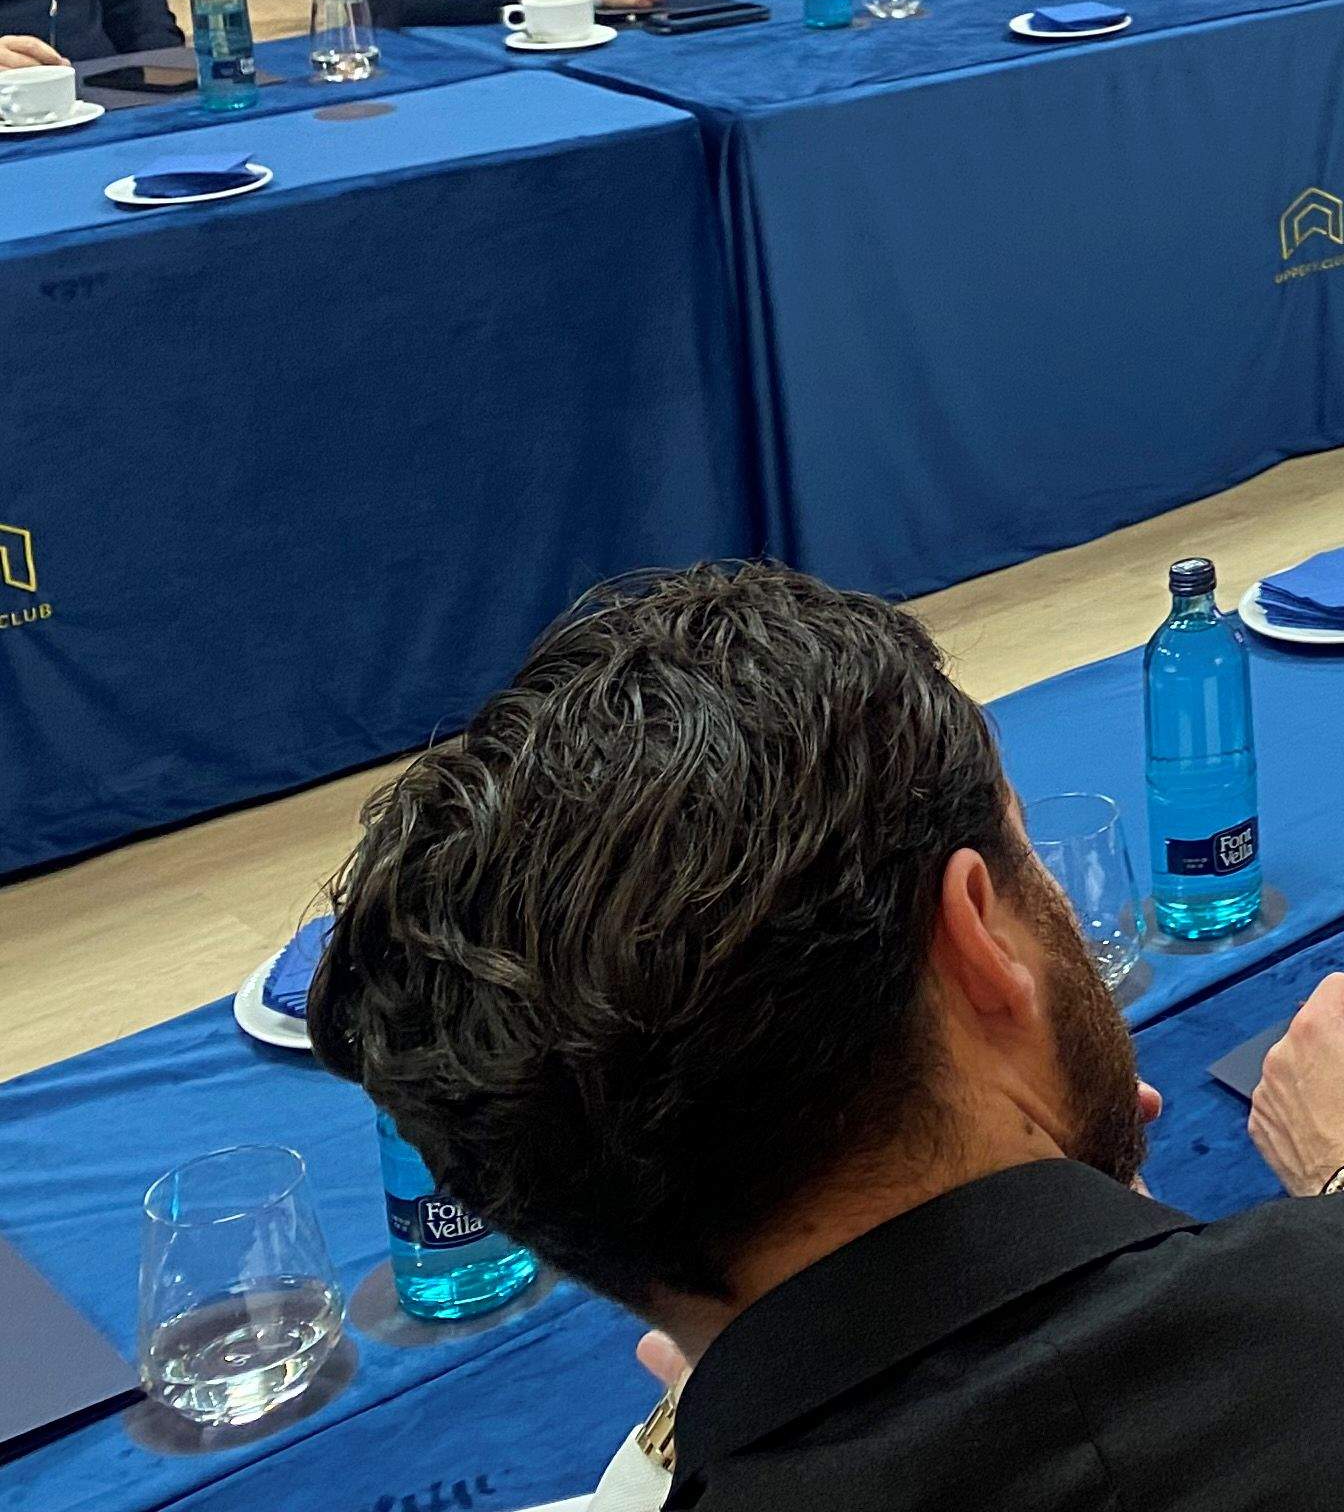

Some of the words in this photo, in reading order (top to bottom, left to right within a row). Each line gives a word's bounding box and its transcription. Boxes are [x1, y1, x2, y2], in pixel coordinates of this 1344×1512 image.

[1220, 828, 1252, 853] Font
[1220, 844, 1253, 866] Vella
[427, 1215, 484, 1239] Vella
